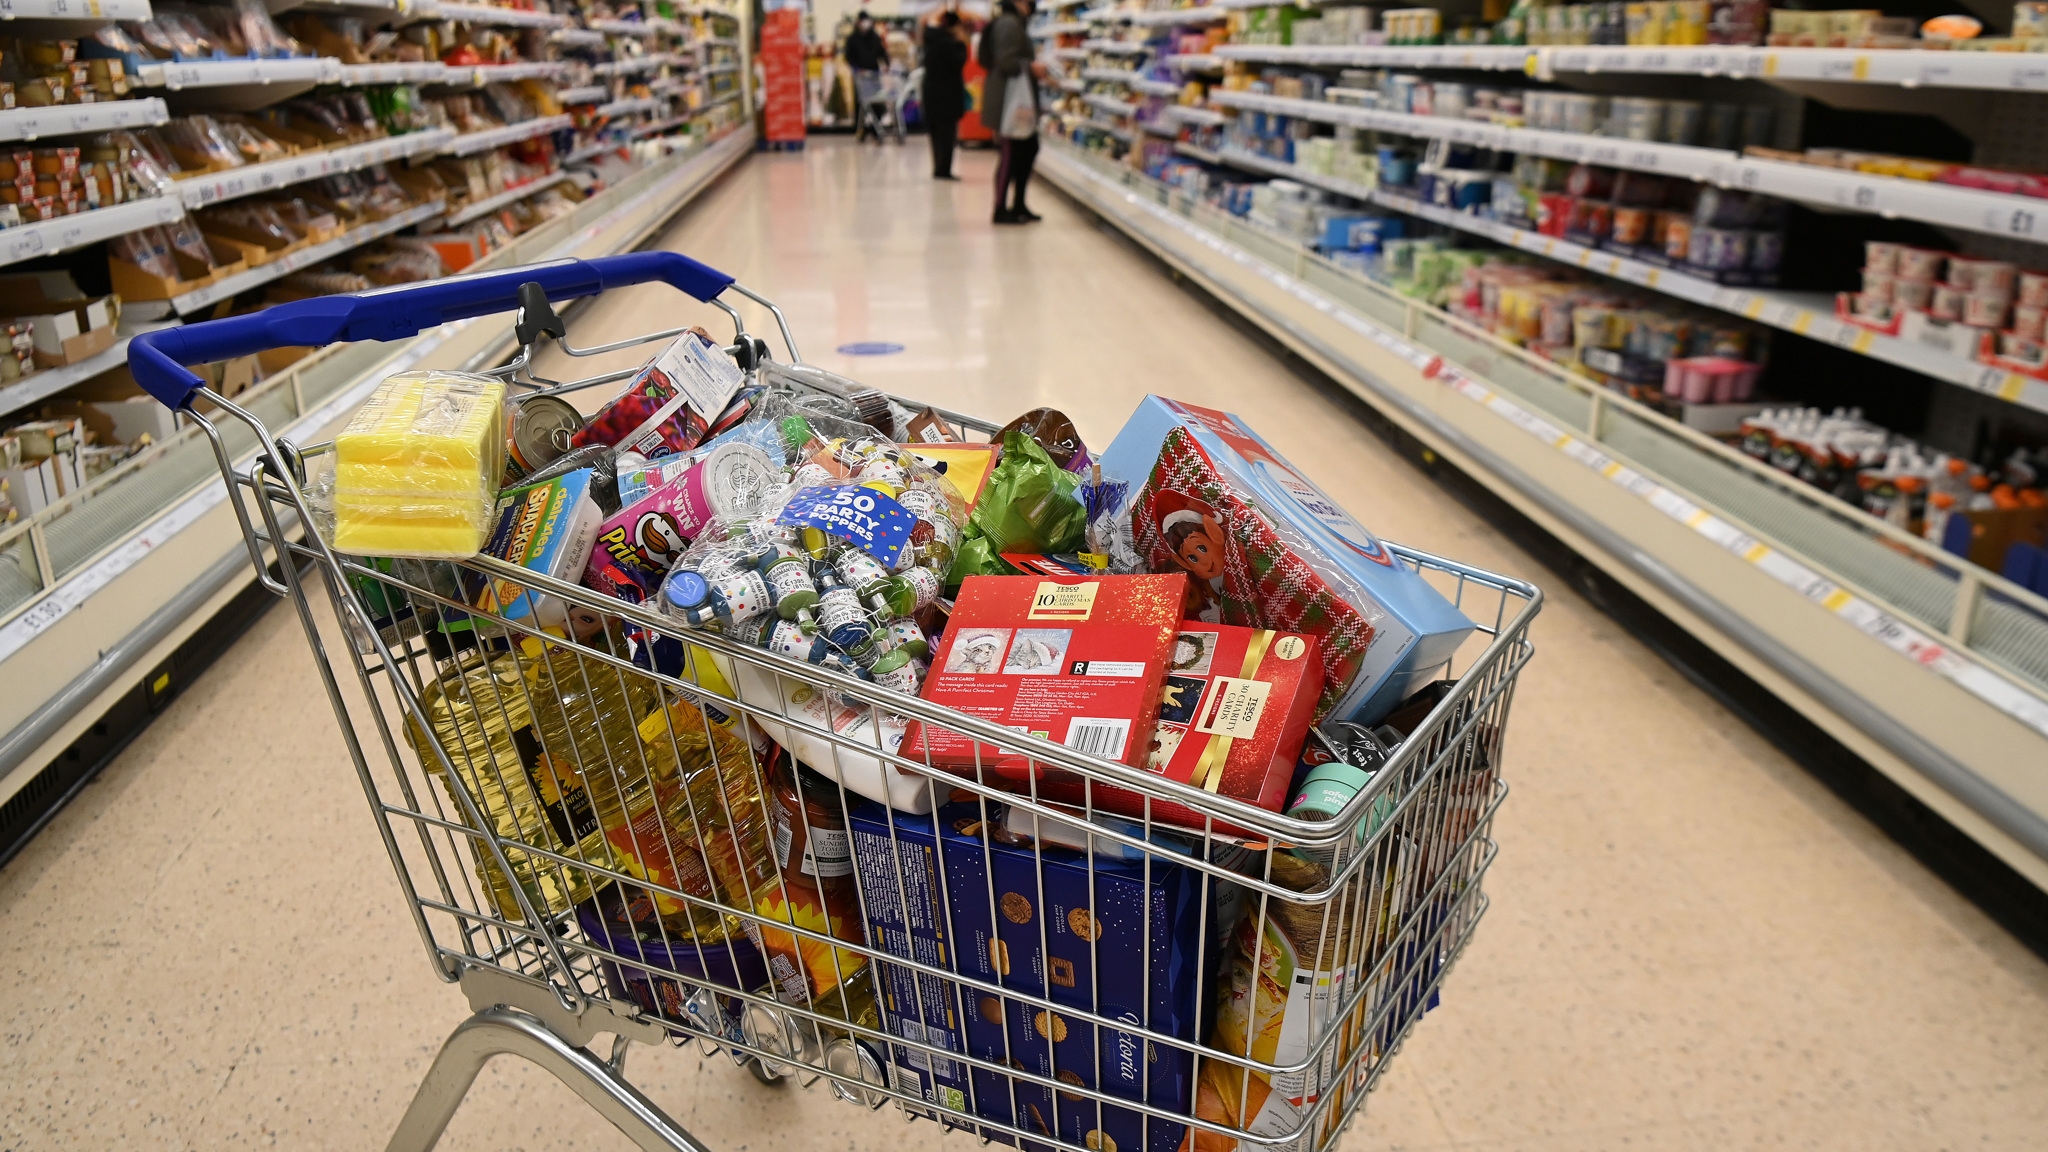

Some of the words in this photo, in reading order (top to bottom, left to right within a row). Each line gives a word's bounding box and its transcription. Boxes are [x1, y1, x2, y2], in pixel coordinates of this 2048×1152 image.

[672, 493, 695, 531] WIN
[683, 488, 696, 515] CHANCE
[692, 516, 701, 526] TO
[832, 492, 875, 513] 50
[532, 488, 567, 558] dairylea
[809, 512, 874, 542] POPPERS
[813, 503, 880, 531] PARTY
[1037, 594, 1055, 606] 10
[24, 602, 62, 629] £1.30
[1287, 637, 1298, 659] Recyclable
[1074, 663, 1084, 672] R
[1242, 683, 1250, 694] 30
[1220, 692, 1236, 720] CARDS
[1226, 694, 1246, 732] CHARITY
[1245, 697, 1259, 722] TESCO
[1322, 788, 1351, 803] safet
[1117, 1012, 1140, 1081] Vctoria
